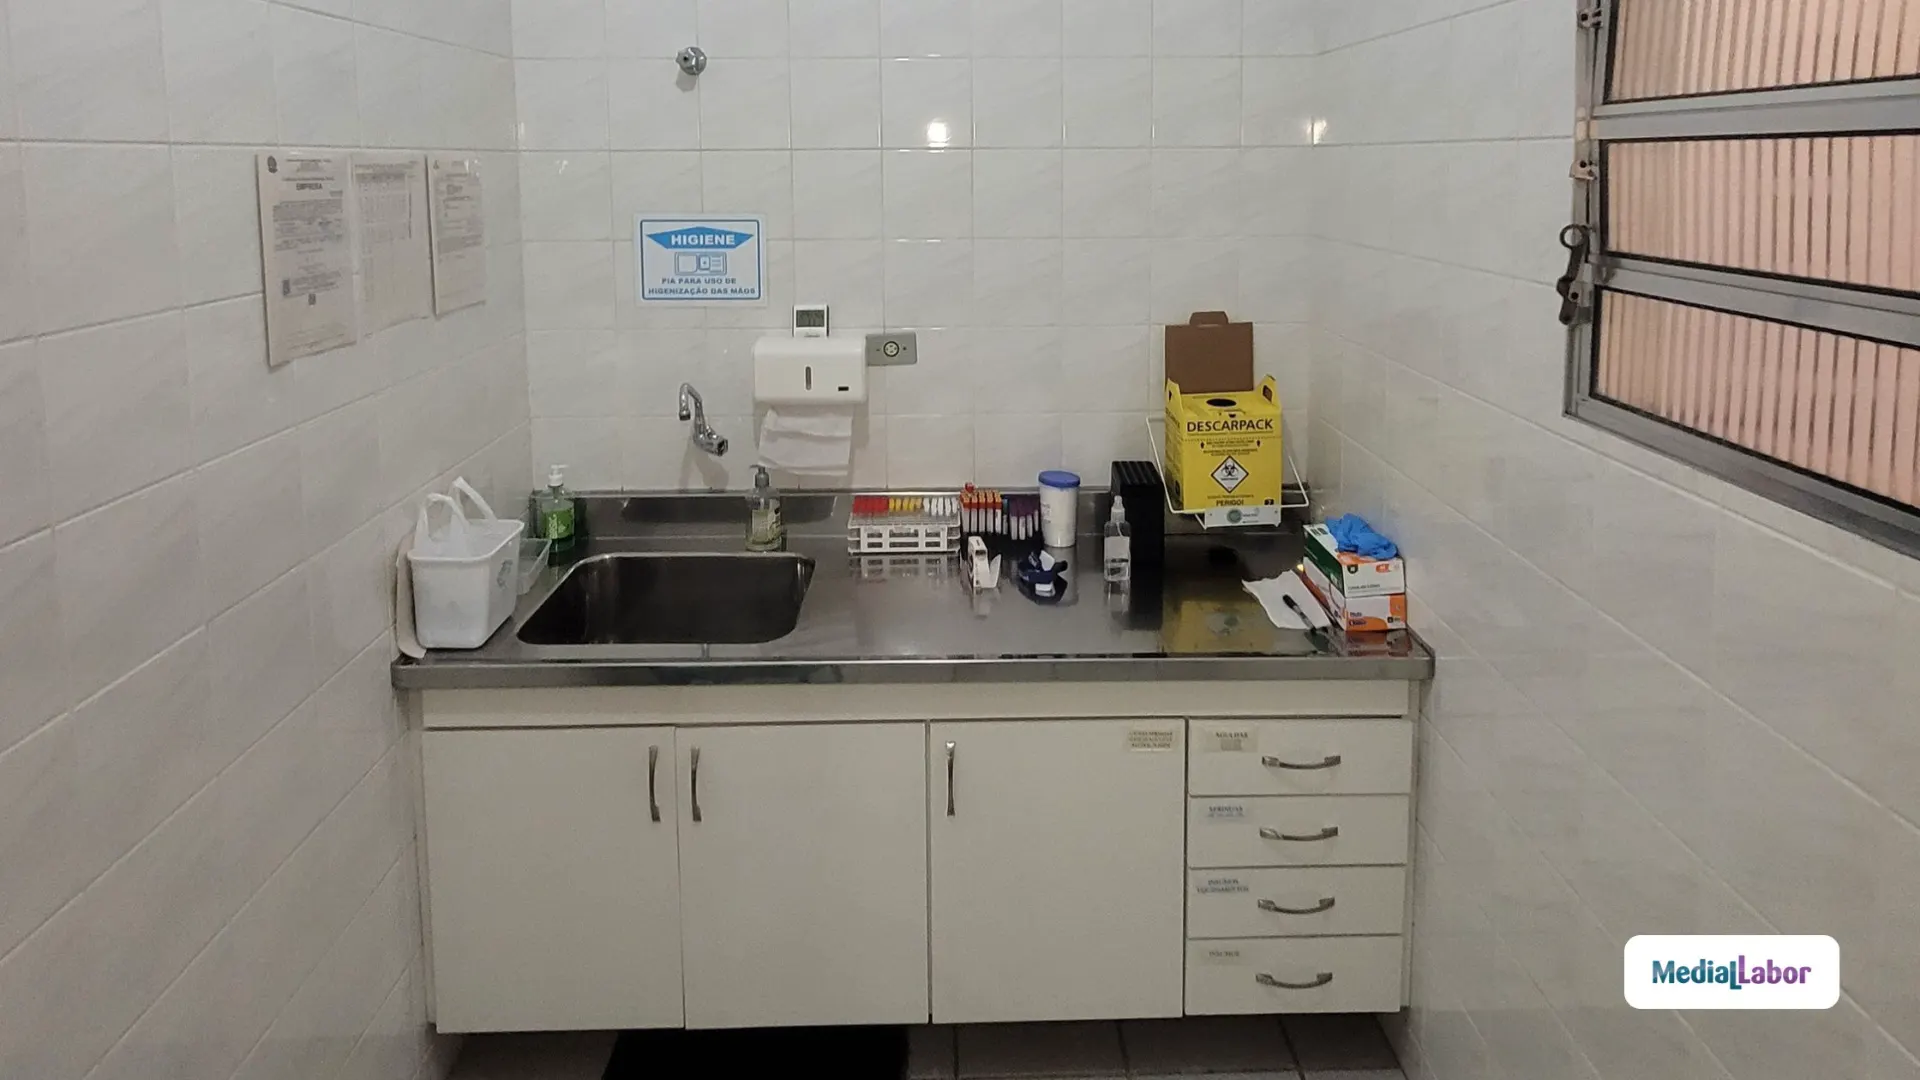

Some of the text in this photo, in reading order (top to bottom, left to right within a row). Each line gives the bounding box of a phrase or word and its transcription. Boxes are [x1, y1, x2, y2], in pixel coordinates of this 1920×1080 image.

[670, 234, 736, 246] HIGIENE
[661, 277, 737, 285] PIA PARA USO DE
[710, 287, 728, 295] DAS
[730, 286, 756, 295] MÃOS
[1186, 418, 1274, 433] DESCARPACK
